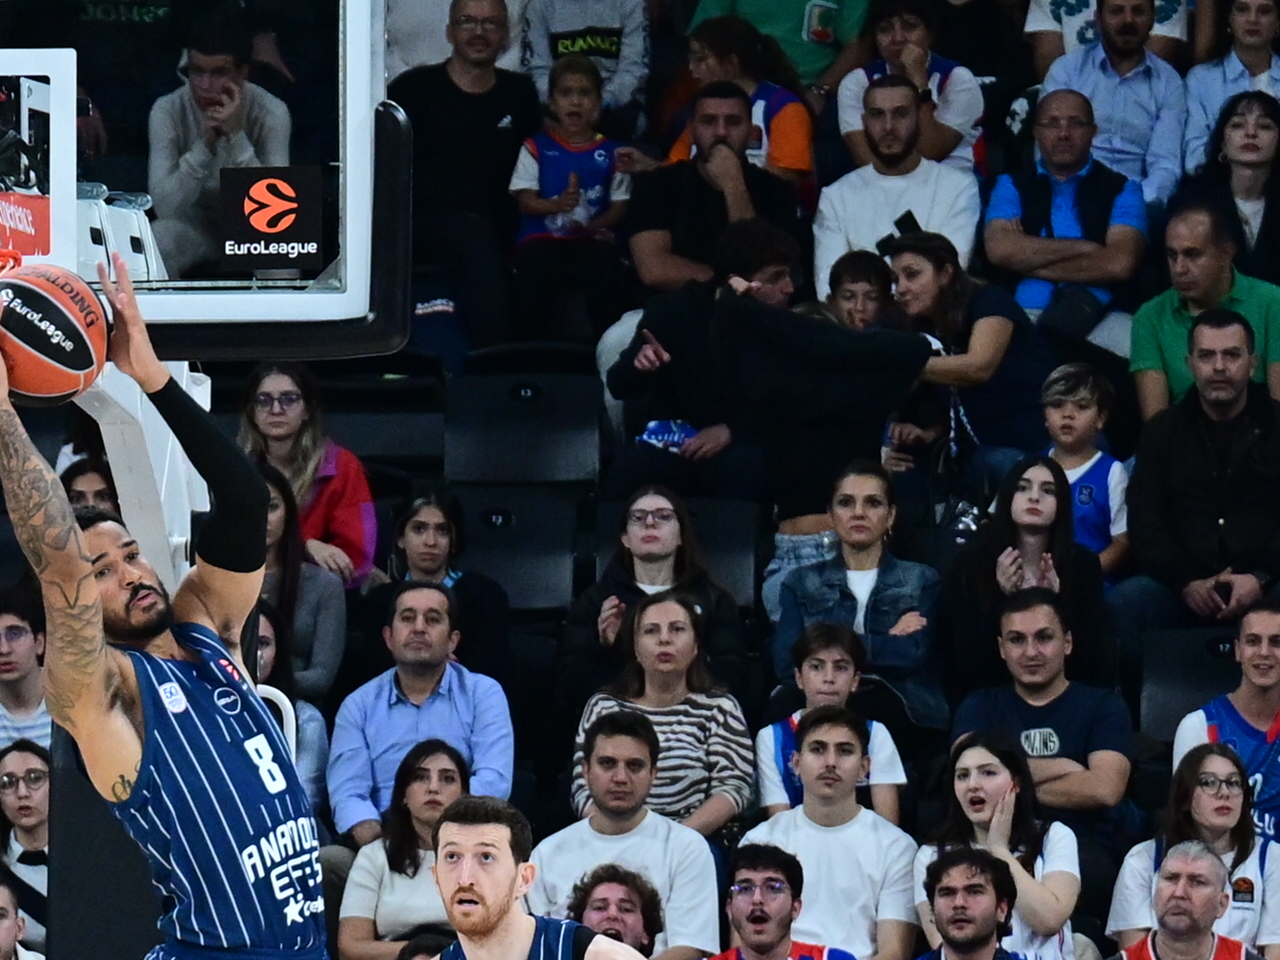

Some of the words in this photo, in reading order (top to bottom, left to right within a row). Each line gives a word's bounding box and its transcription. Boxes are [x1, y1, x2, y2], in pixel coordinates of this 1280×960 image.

[225, 240, 318, 258] EuroLeague
[9, 297, 75, 352] EuroLeague
[244, 733, 287, 795] 8
[242, 816, 319, 884] ANADOL
